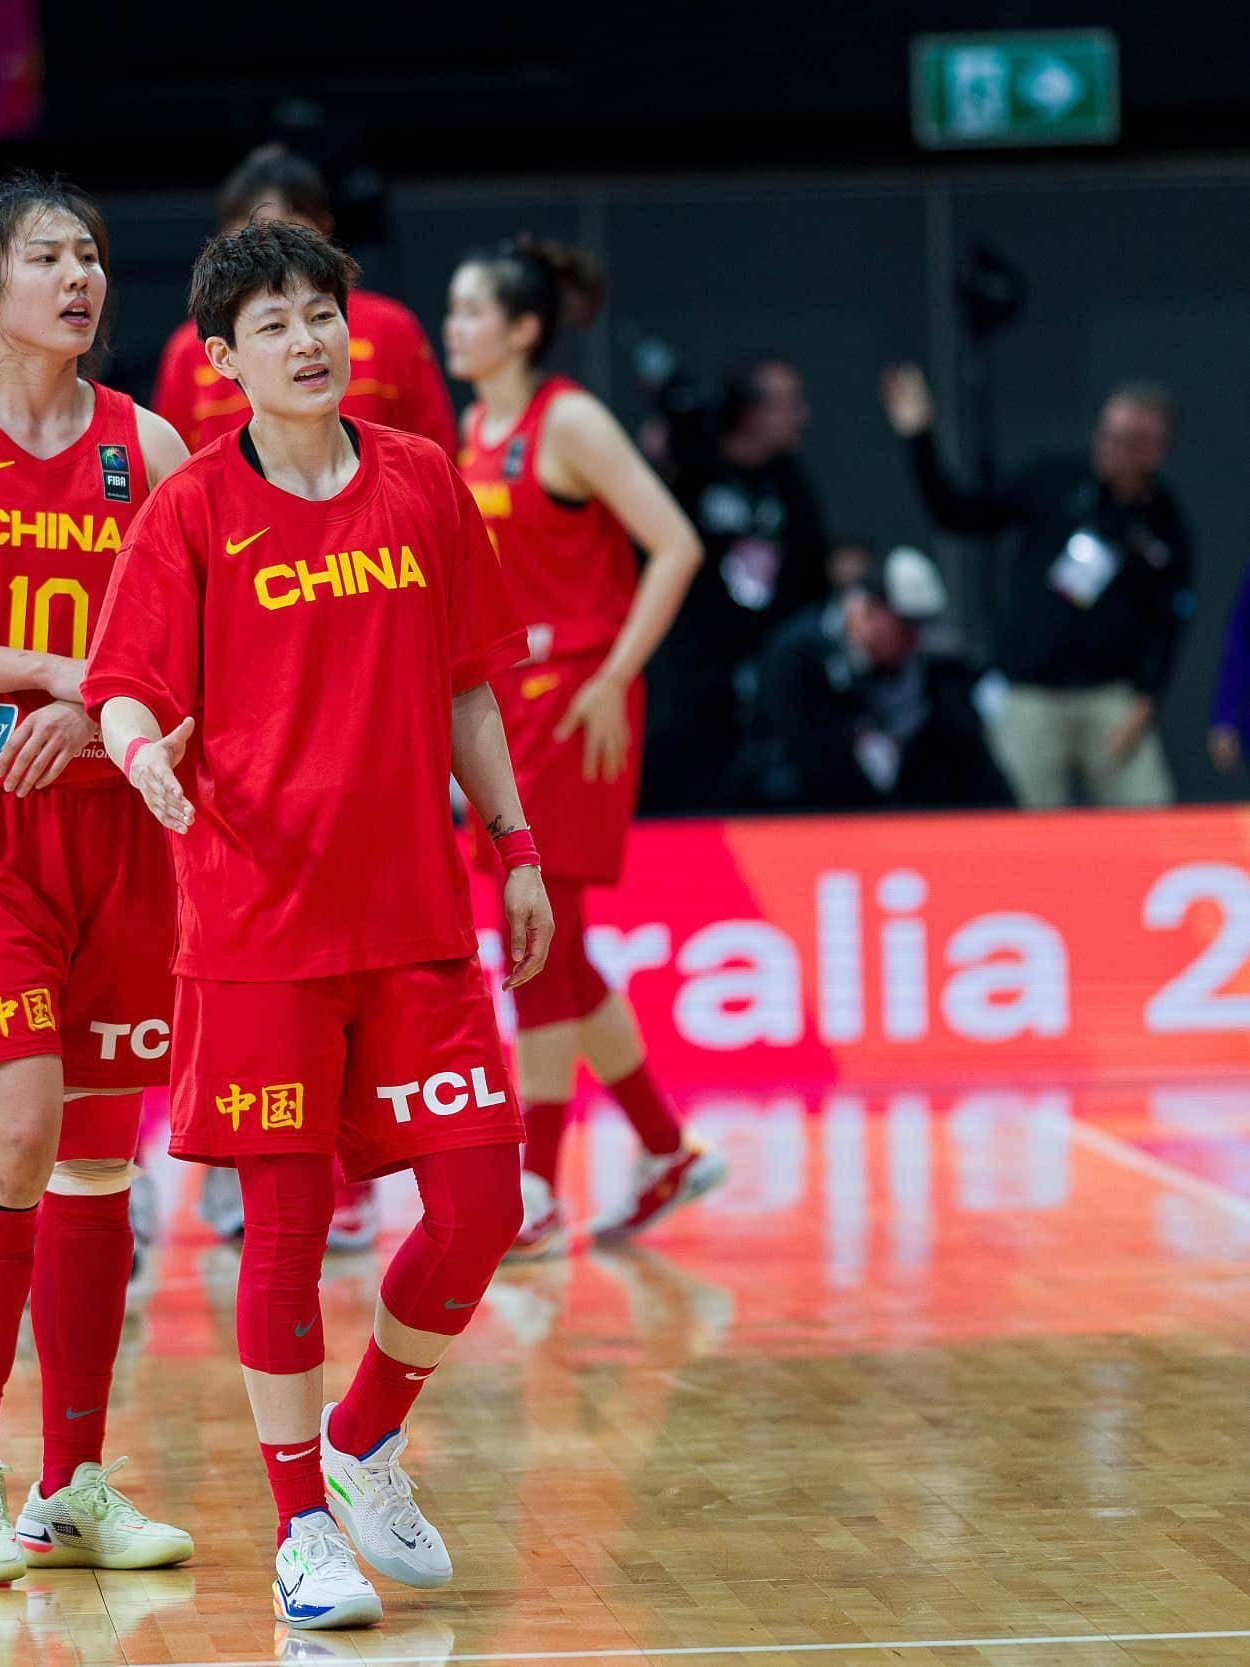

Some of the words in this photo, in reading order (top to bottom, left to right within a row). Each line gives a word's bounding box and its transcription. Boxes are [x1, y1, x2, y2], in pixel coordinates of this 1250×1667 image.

[107, 475, 126, 488] FIBA
[253, 545, 428, 611] CHINA
[8, 575, 89, 660] 10
[583, 869, 1072, 1050] ralia
[89, 1018, 171, 1060] TC
[215, 1082, 304, 1132] 中国
[376, 1066, 506, 1123] TCL
